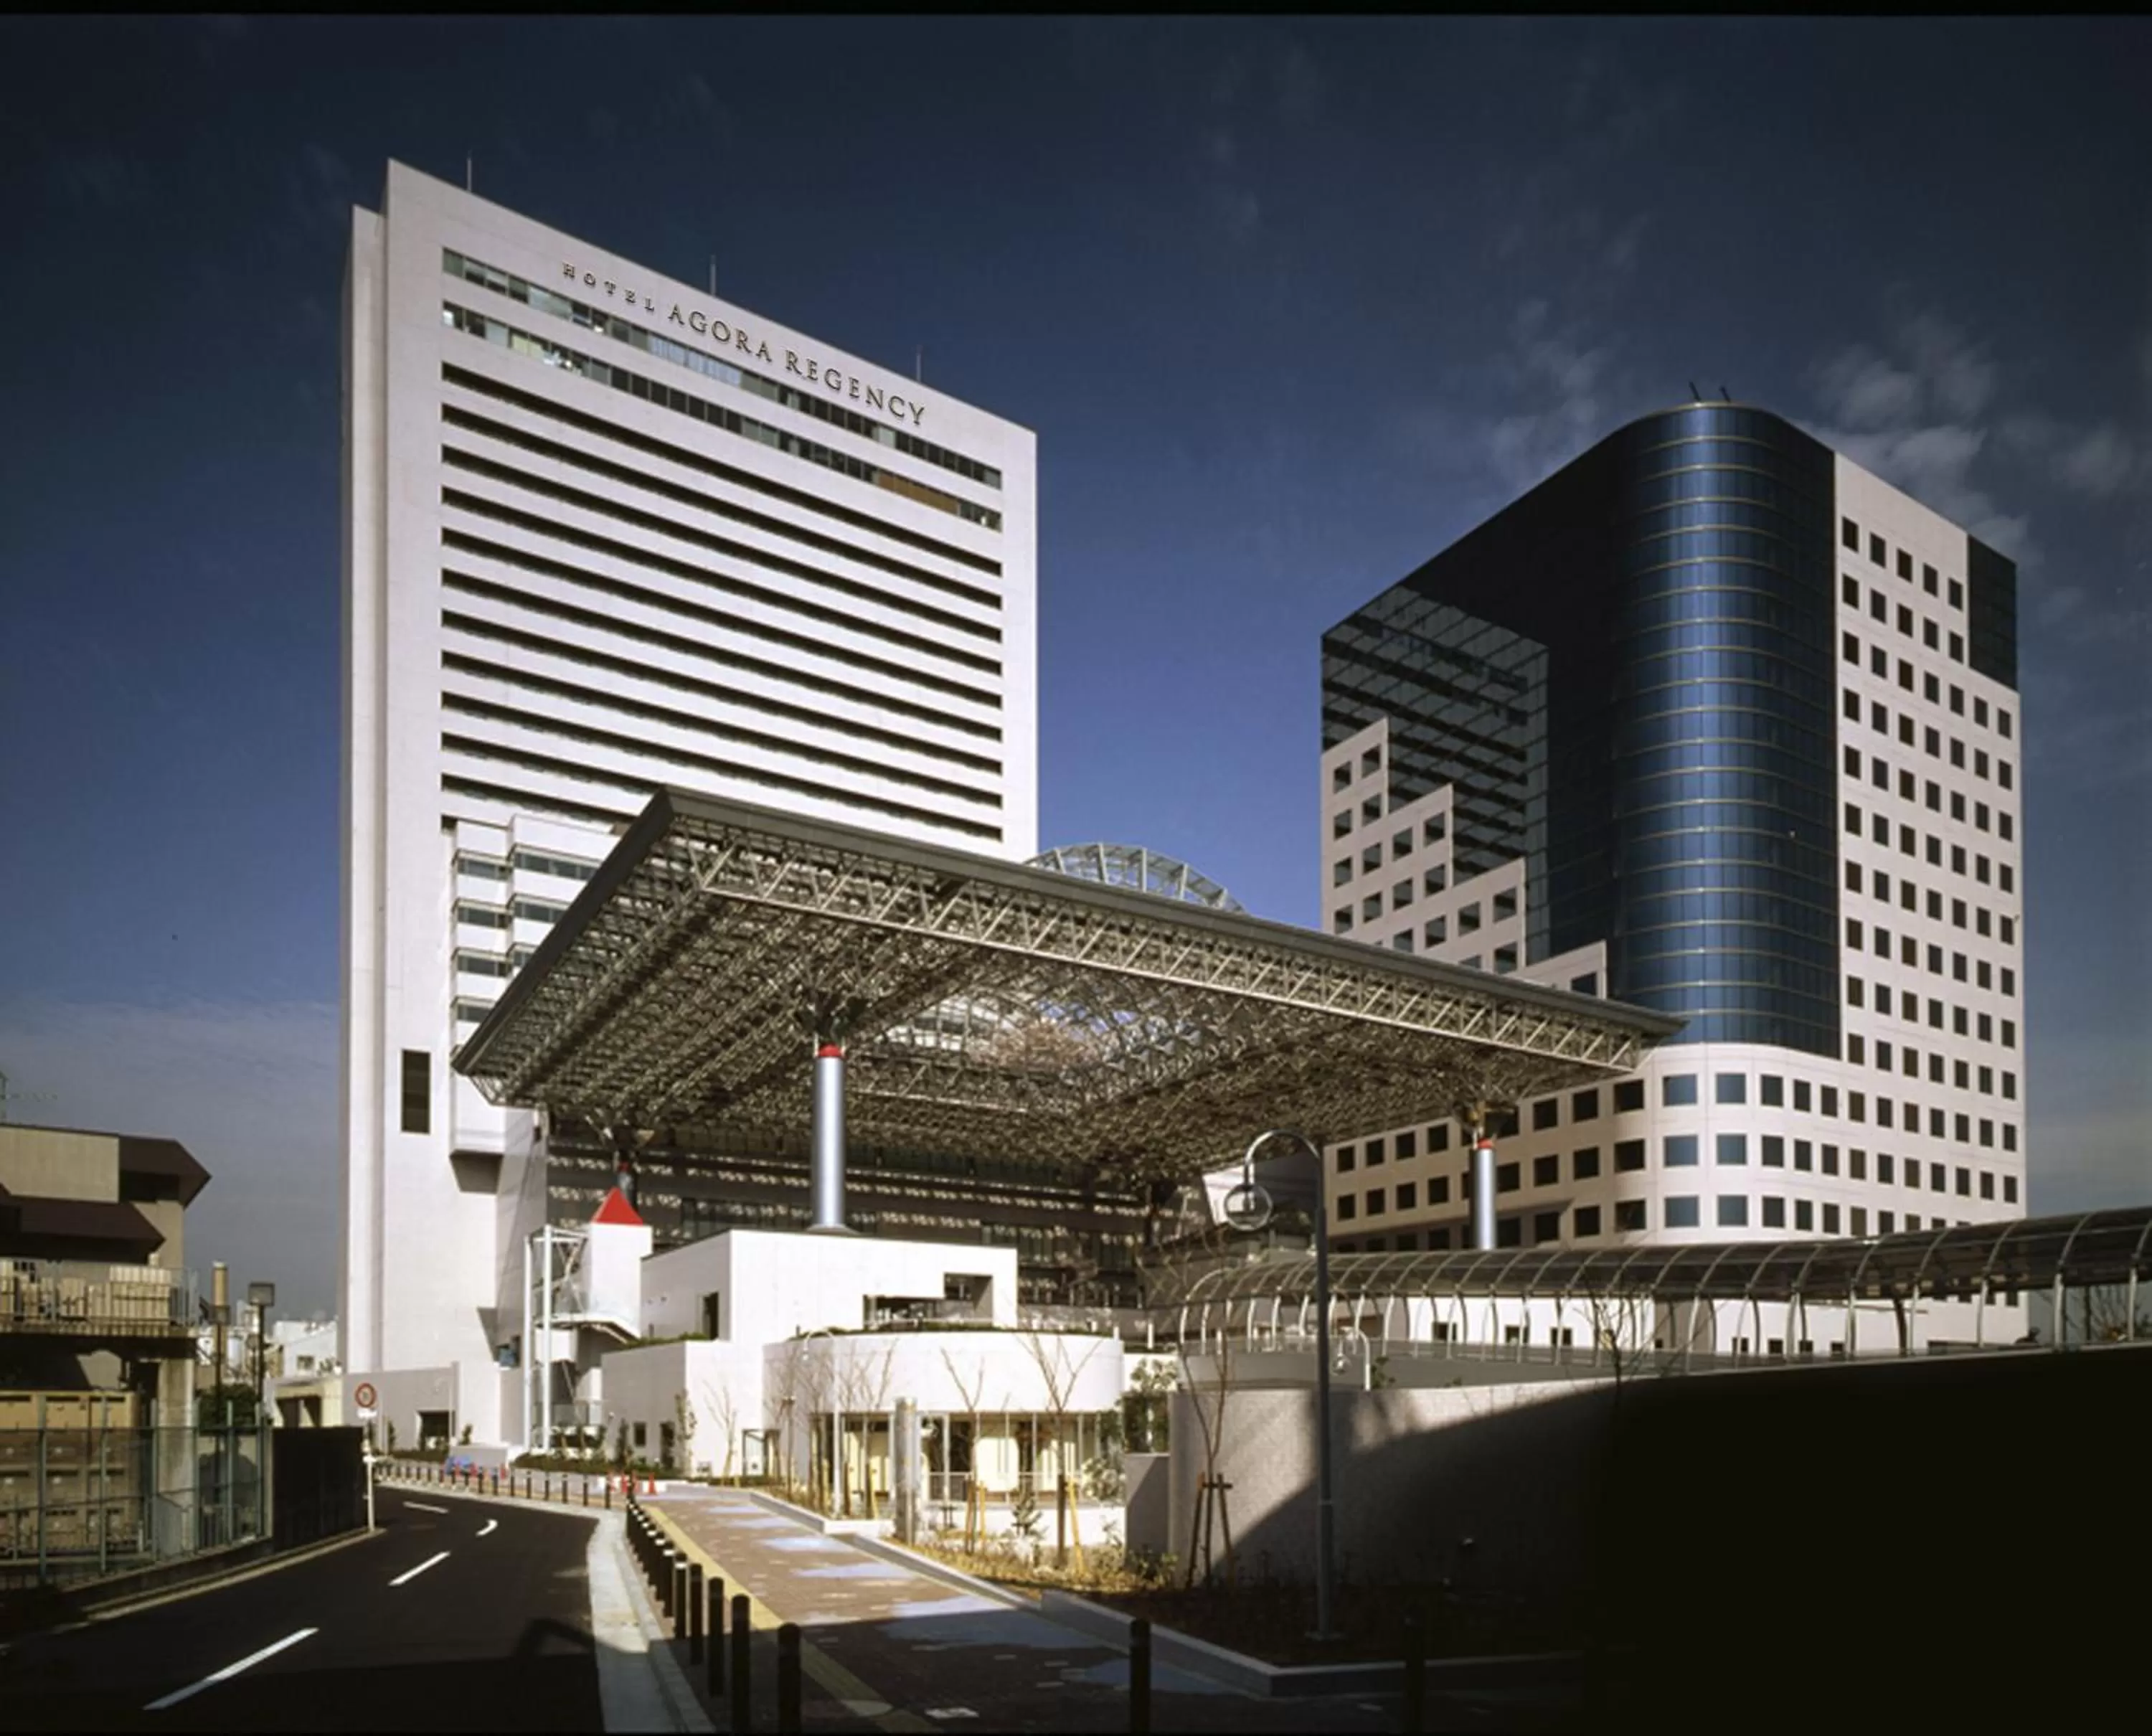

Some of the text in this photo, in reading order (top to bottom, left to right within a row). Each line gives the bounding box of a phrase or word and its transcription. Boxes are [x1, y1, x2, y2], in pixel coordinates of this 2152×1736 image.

[562, 263, 925, 425] HOTEL AGORA REGENCY
